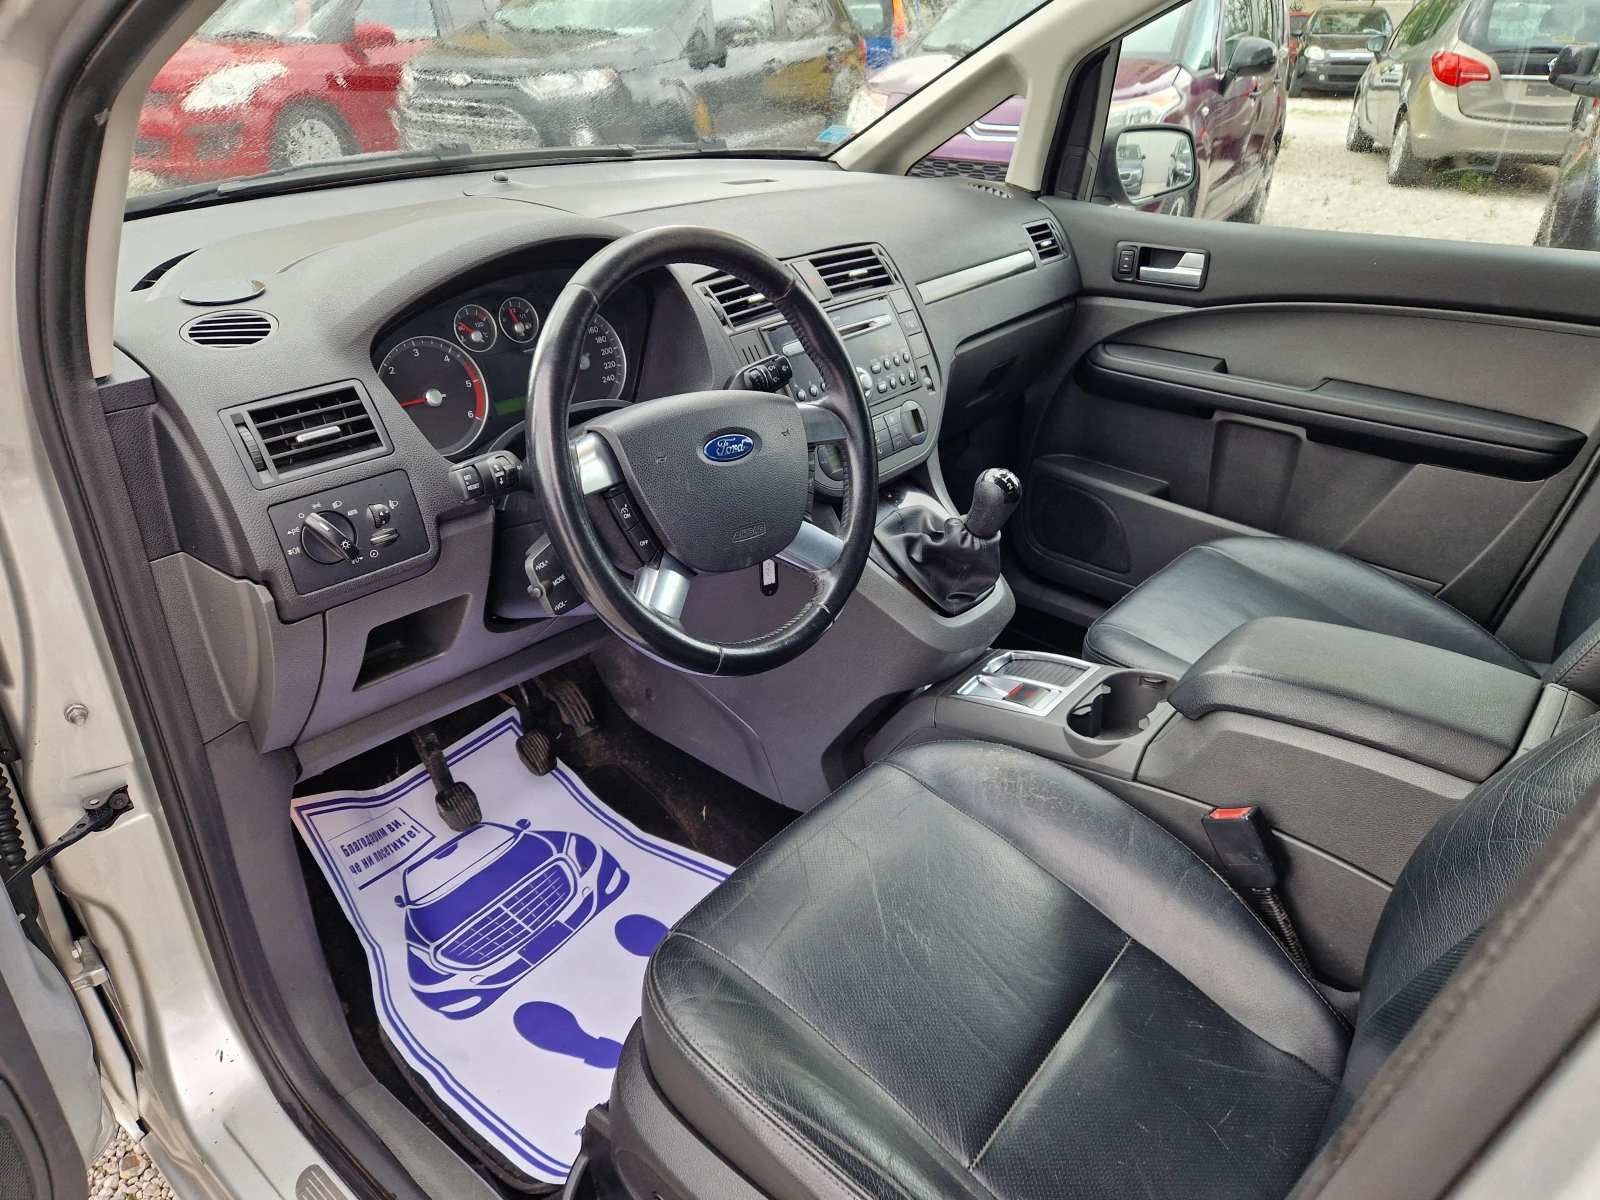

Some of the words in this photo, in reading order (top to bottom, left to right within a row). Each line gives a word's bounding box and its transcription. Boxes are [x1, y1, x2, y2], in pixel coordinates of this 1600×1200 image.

[595, 335, 606, 344] 180
[412, 348, 420, 357] 3
[600, 346, 613, 356] 200
[443, 354, 450, 362] 4
[603, 360, 616, 370] 220
[388, 366, 396, 375] 2
[601, 374, 615, 384] 240
[465, 380, 472, 388] 5
[467, 410, 474, 419] 6
[716, 437, 745, 456] Ford
[467, 482, 480, 491] RESET
[733, 523, 764, 540] AIRBAG
[639, 539, 649, 547] OFF
[552, 573, 567, 587] MODE
[340, 827, 388, 857] Благодарим
[349, 862, 362, 875] че
[361, 855, 375, 869] ни
[372, 825, 421, 863] посетихте!
